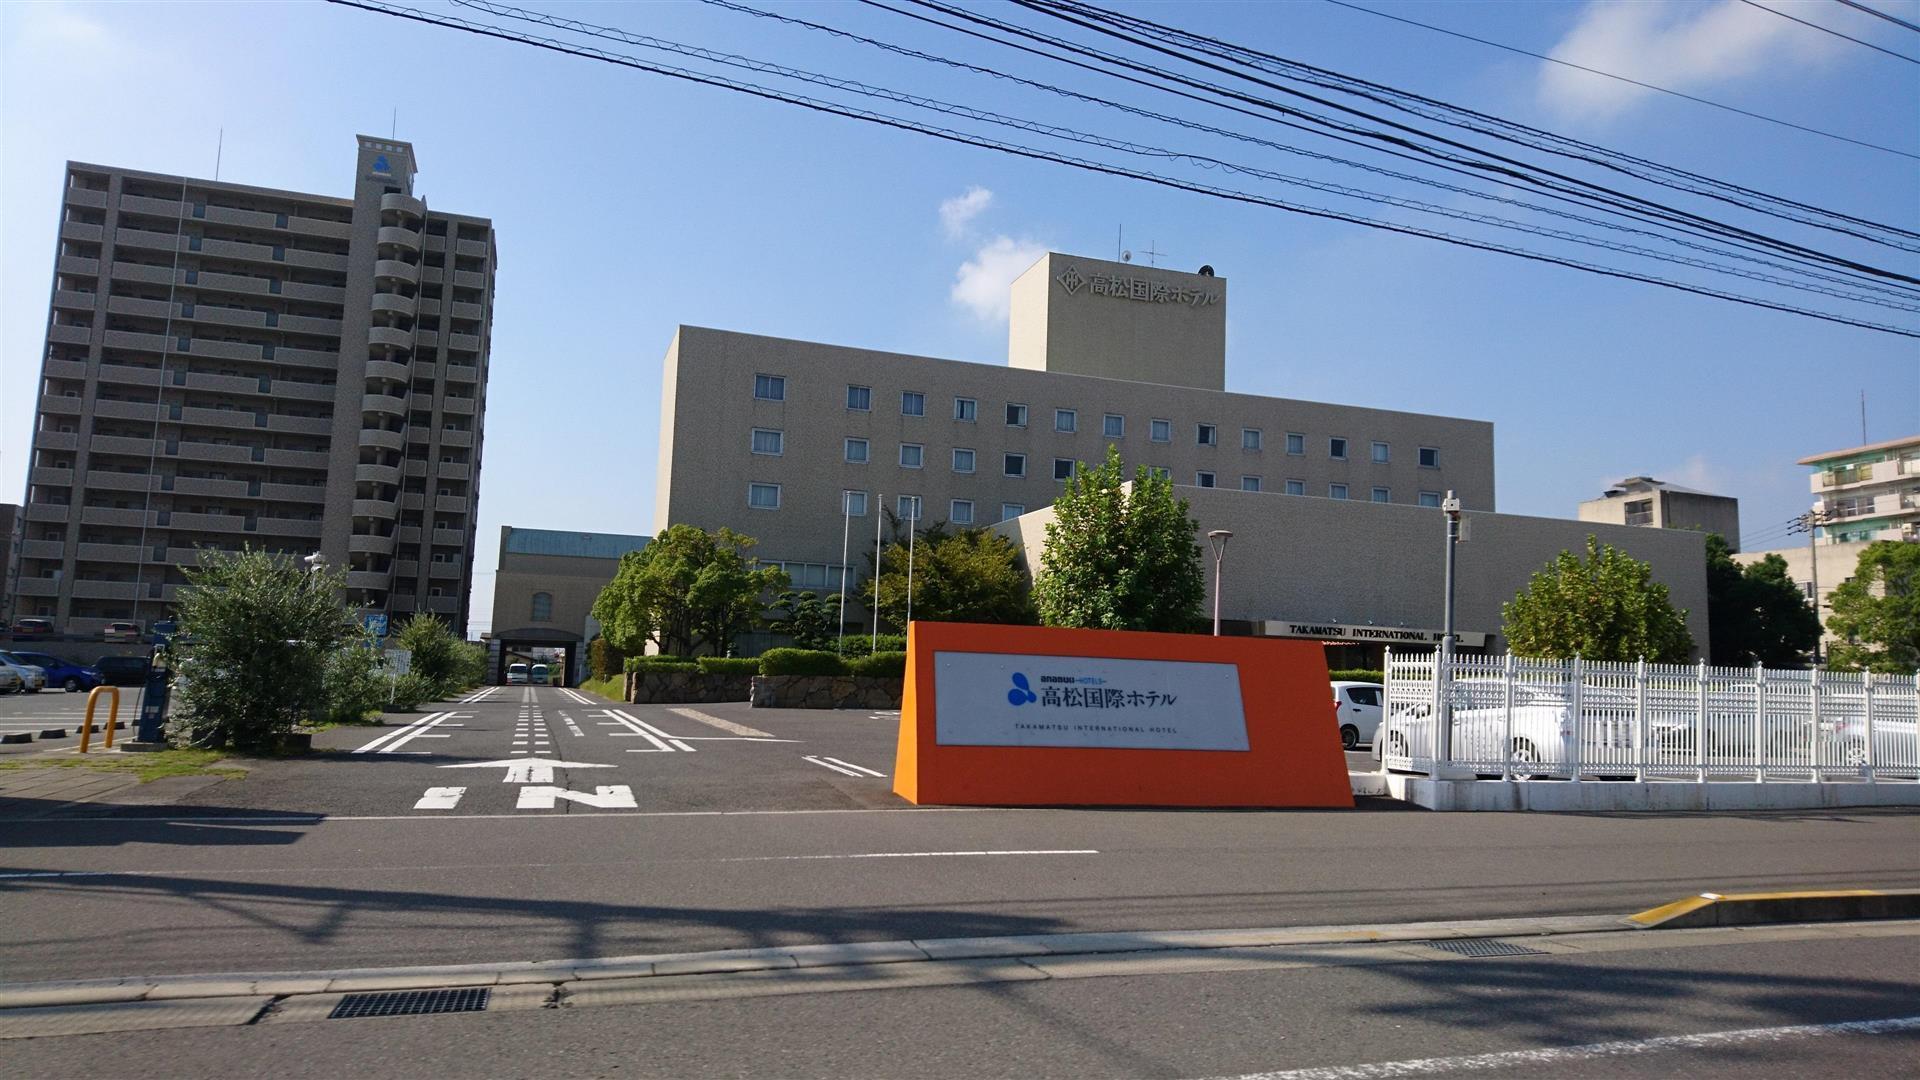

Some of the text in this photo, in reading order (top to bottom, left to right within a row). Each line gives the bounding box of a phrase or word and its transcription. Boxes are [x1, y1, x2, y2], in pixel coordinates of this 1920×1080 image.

[1089, 272, 1221, 306] 高松国際ホテル
[1289, 625, 1346, 636] TAKAMATSU
[1352, 628, 1427, 641] INTERNATIONAL
[1041, 686, 1178, 709] 高松国際ホテル
[1015, 723, 1069, 731] TAKAMATSU
[1074, 725, 1145, 733] INTERNATIONAL
